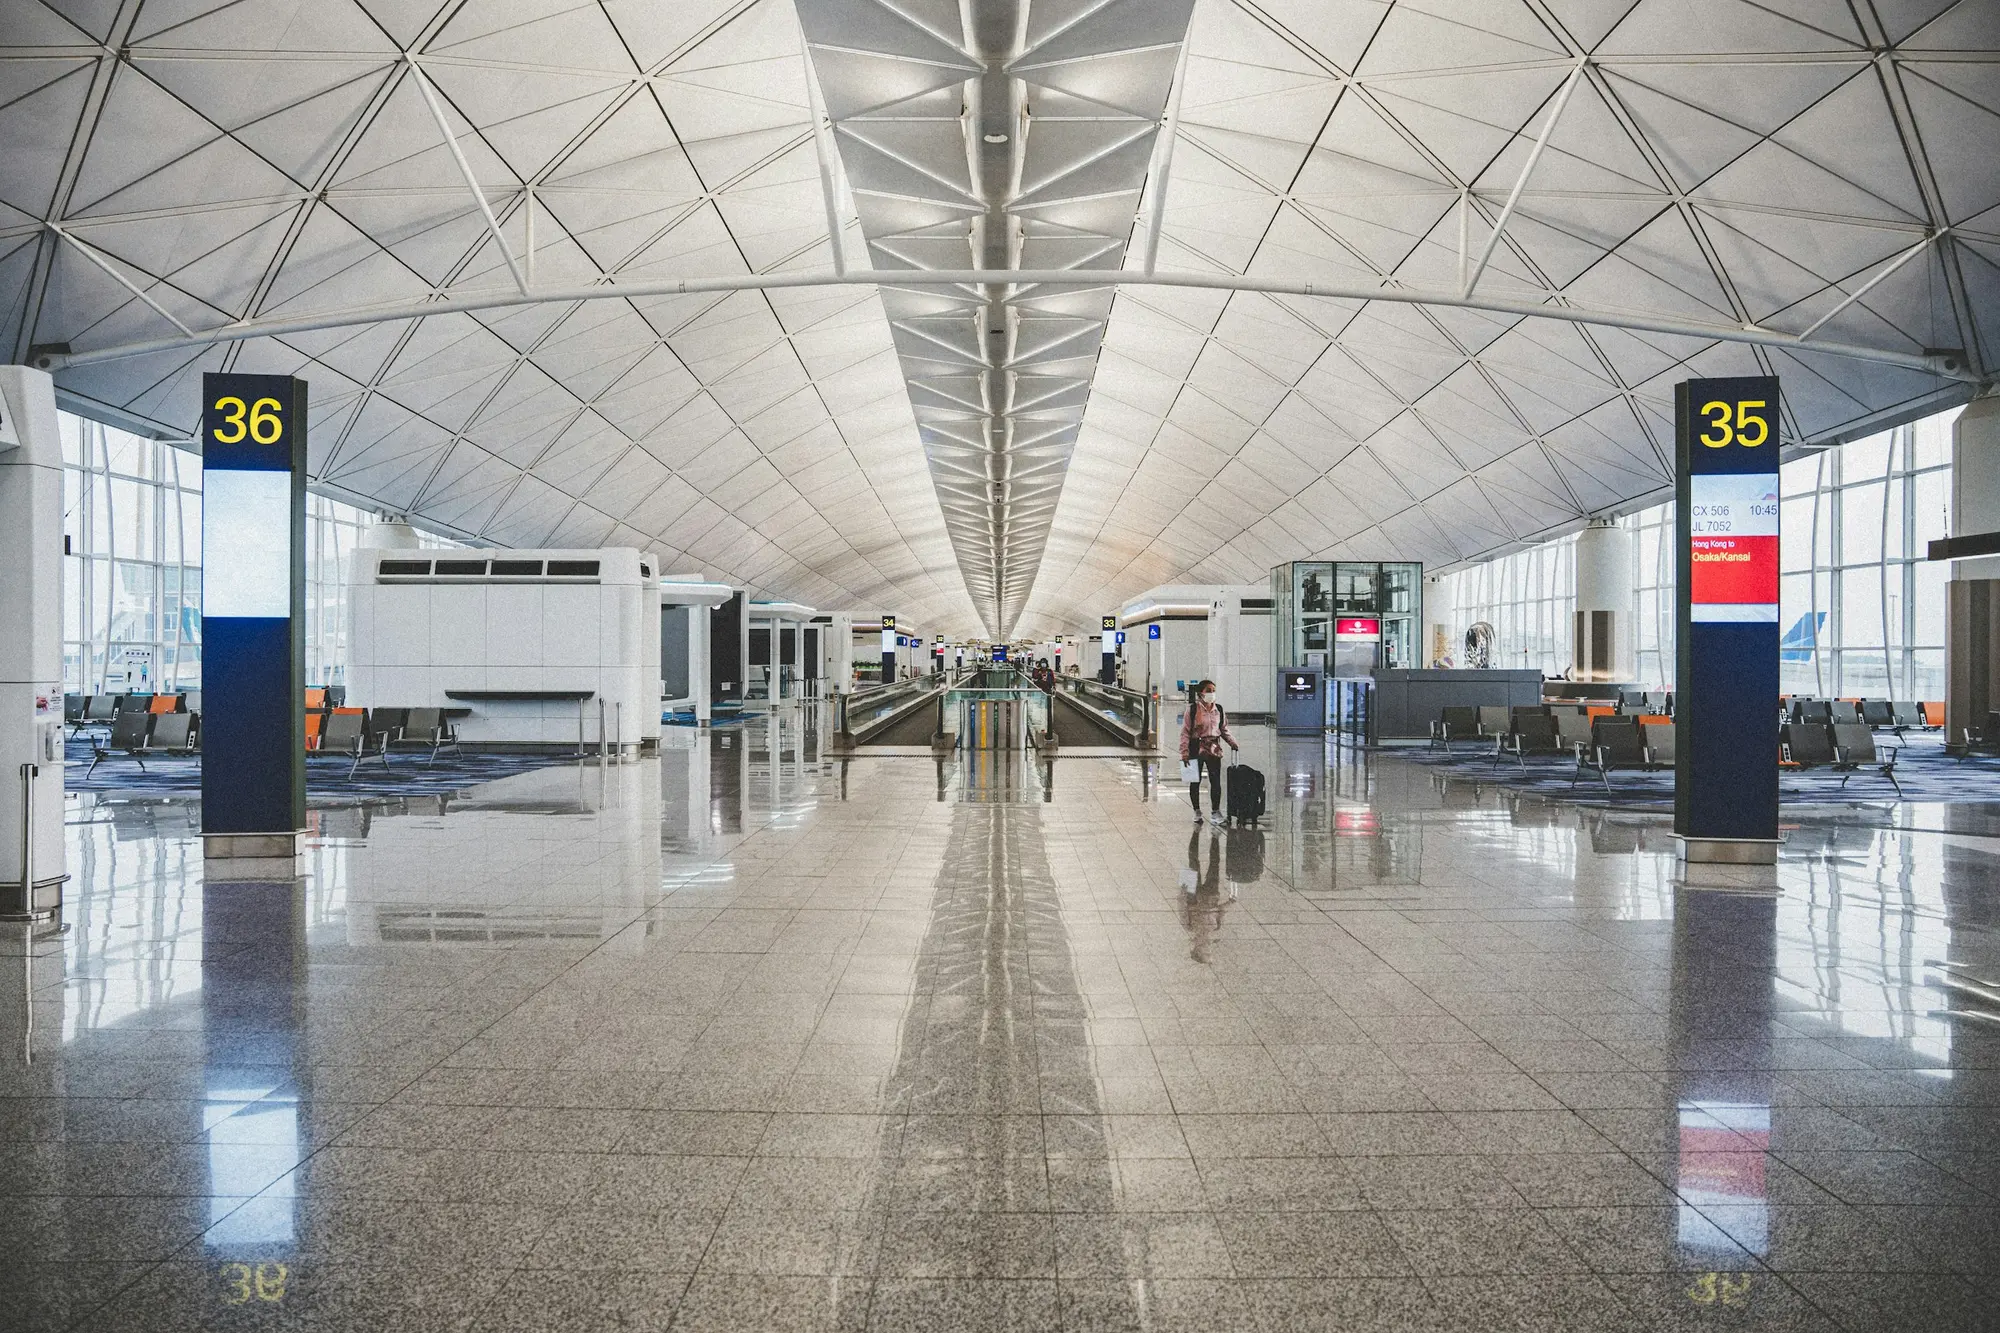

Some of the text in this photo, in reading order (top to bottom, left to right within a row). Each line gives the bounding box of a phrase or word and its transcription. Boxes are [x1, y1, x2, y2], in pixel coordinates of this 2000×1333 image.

[213, 396, 283, 445] 36
[1700, 400, 1769, 448] 35
[1692, 505, 1730, 516] CX 506
[1750, 504, 1778, 516] 10:45
[1692, 521, 1732, 532] JL 7052
[1692, 540, 1736, 550] Hong Kong to
[1692, 552, 1751, 562] Osaka/Kansai
[883, 618, 895, 627] 34
[1103, 619, 1115, 628] 33
